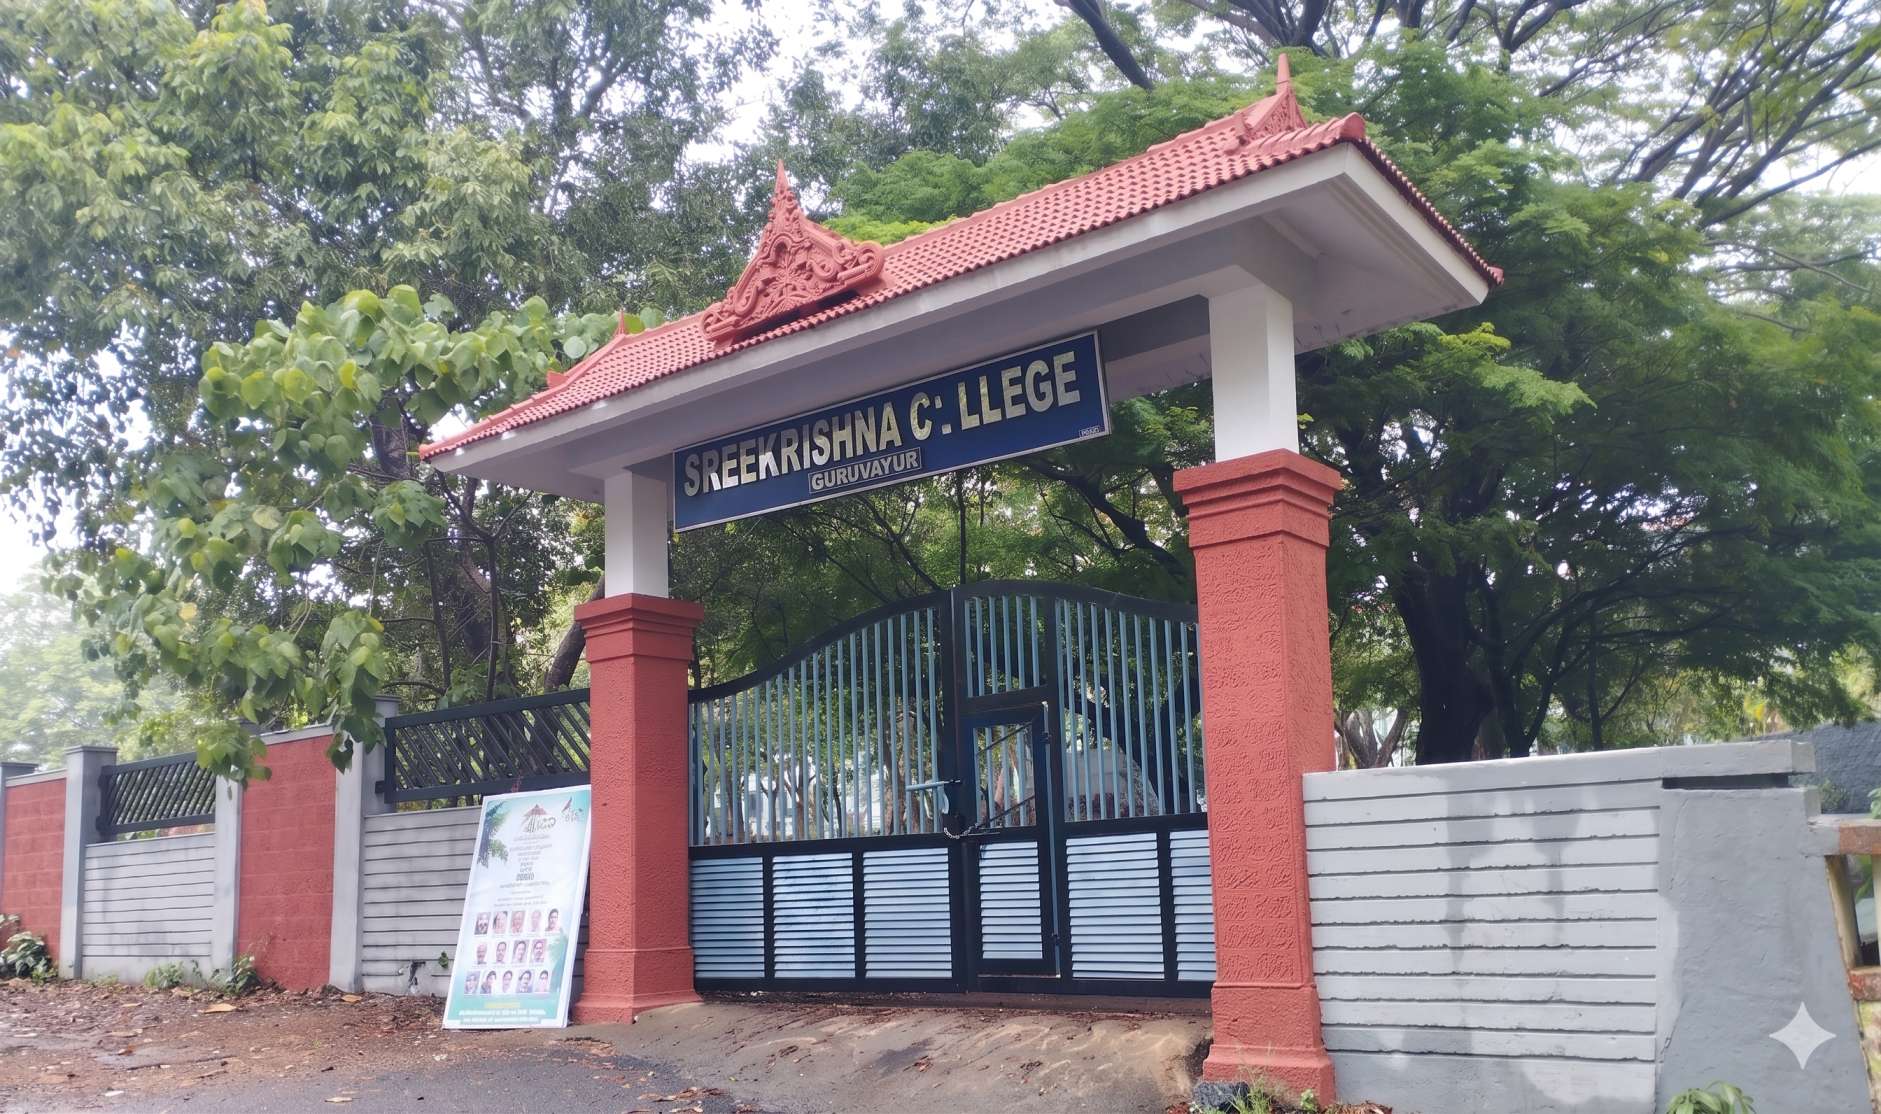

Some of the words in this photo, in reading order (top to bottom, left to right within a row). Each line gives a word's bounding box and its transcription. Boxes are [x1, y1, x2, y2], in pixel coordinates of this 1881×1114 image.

[684, 402, 902, 497] SREEKRISHNA
[909, 351, 1081, 441] CLLEGE
[811, 451, 919, 491] GURUVAYUR
